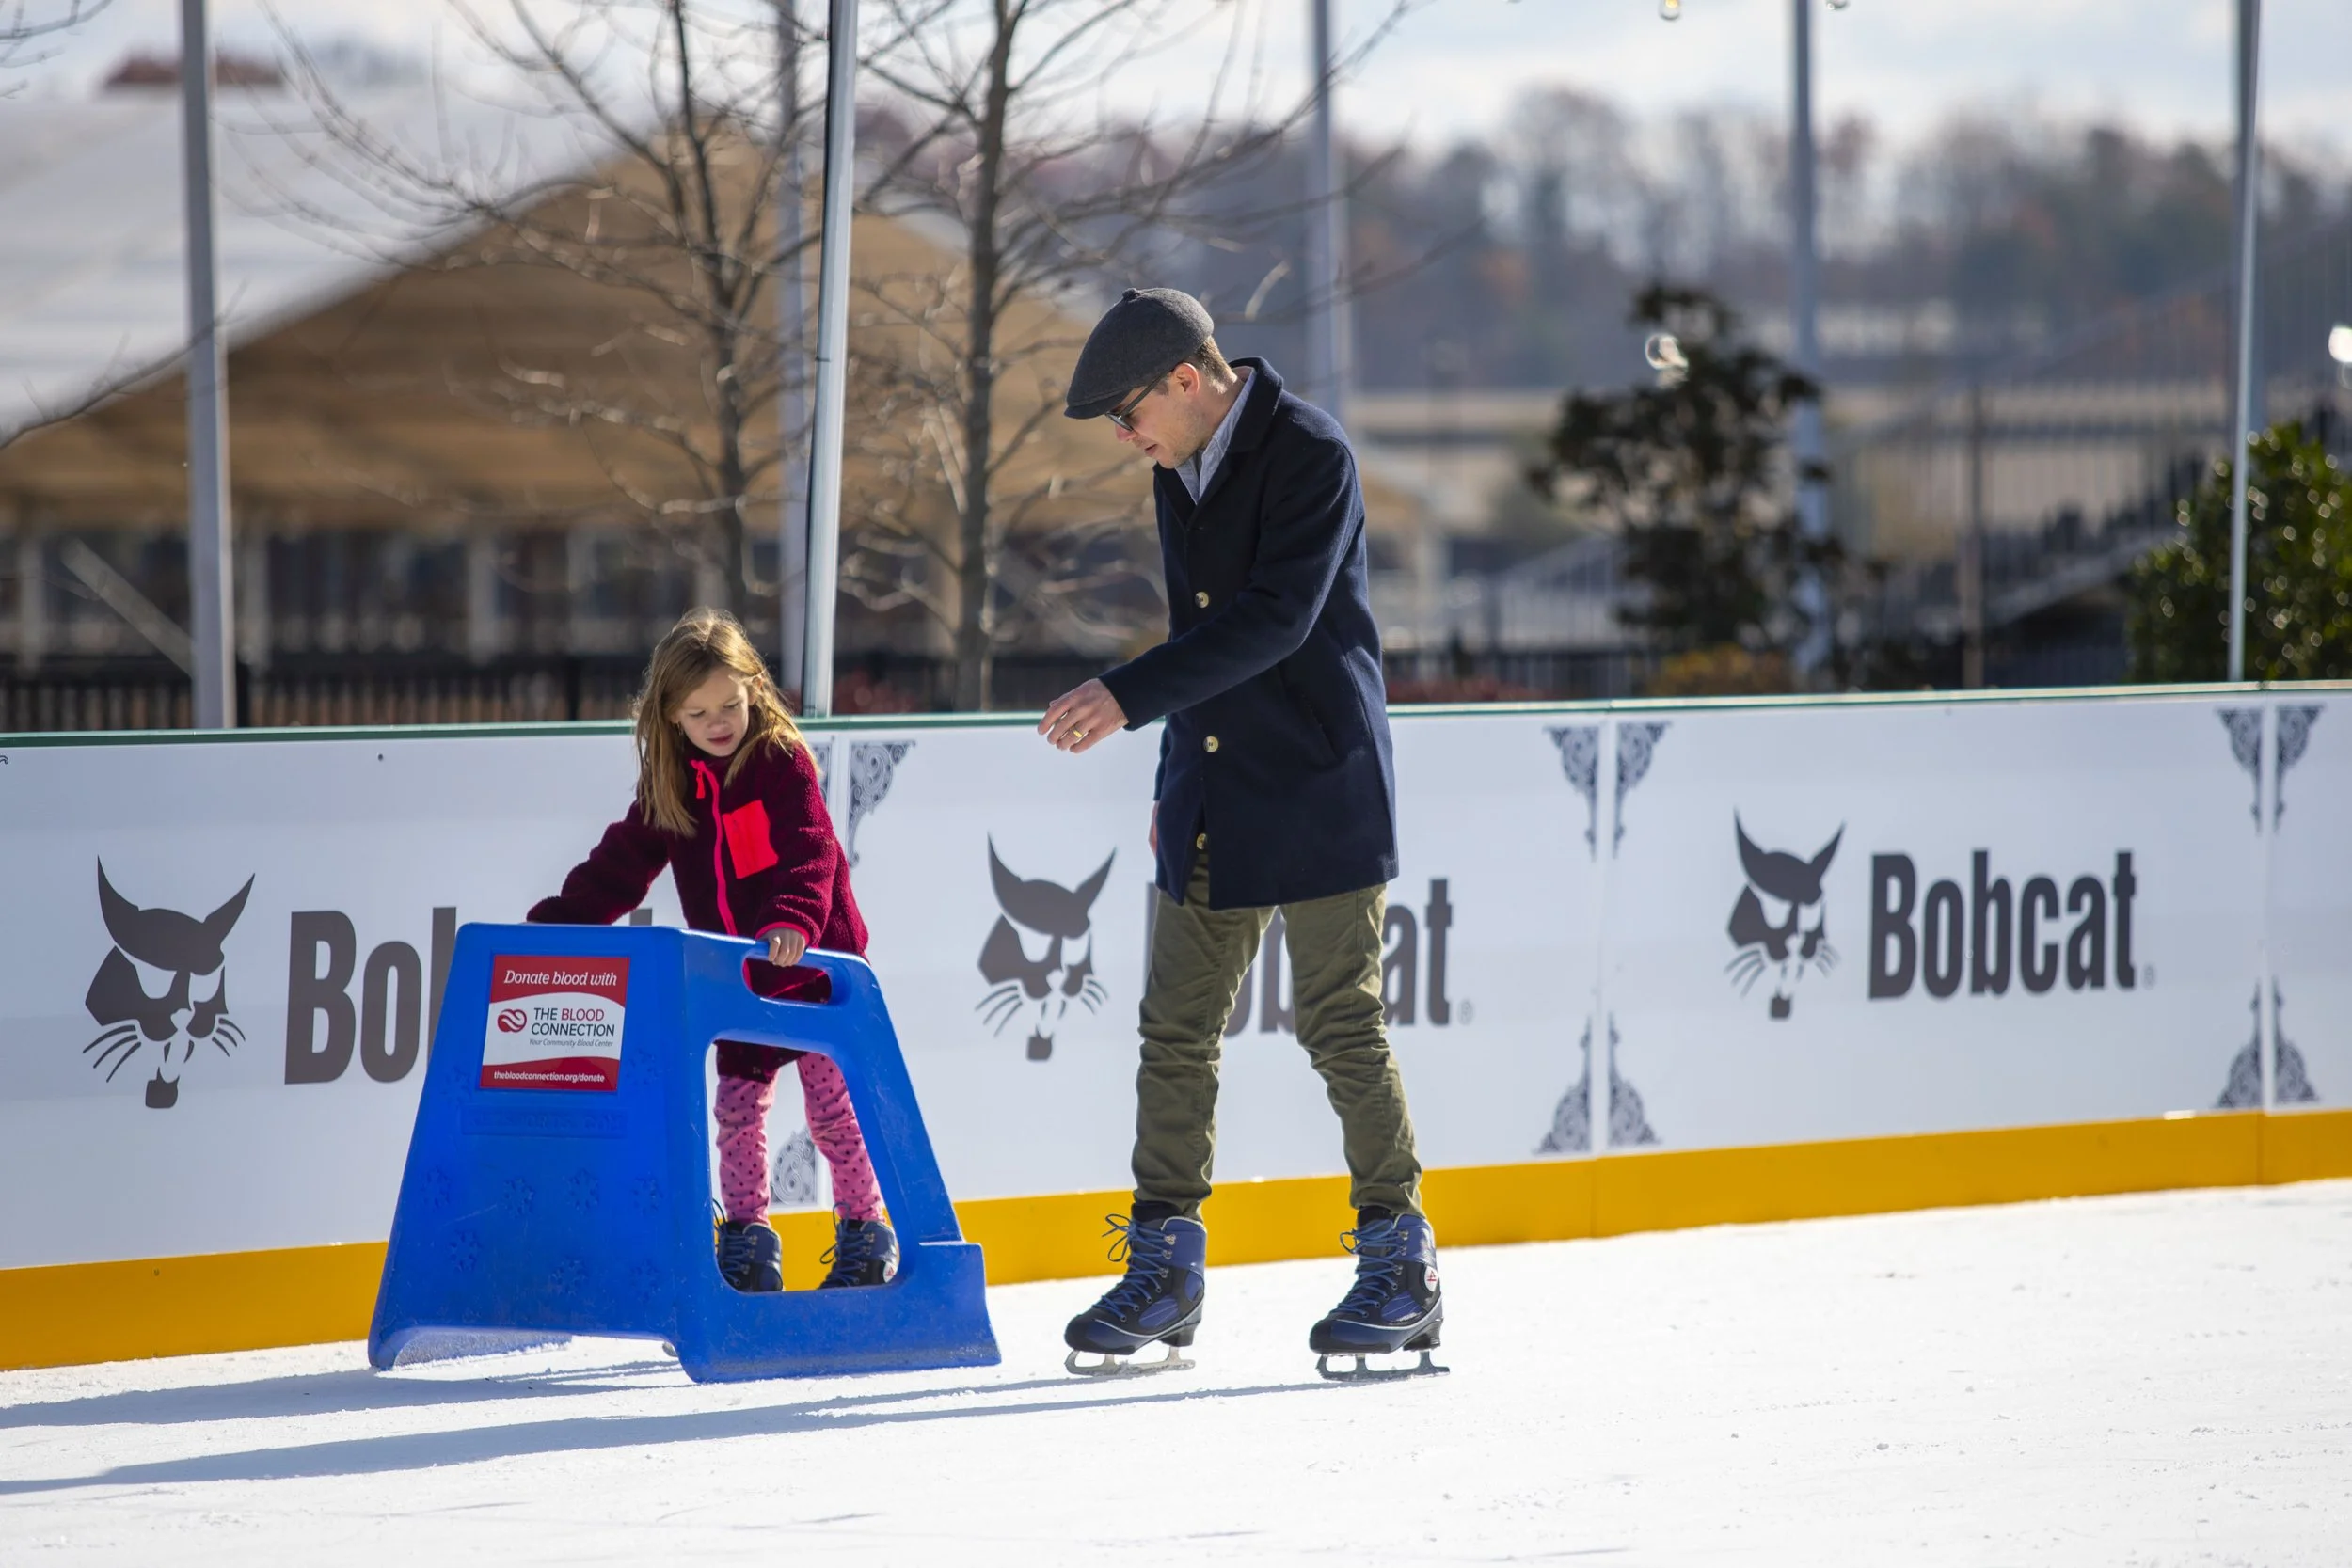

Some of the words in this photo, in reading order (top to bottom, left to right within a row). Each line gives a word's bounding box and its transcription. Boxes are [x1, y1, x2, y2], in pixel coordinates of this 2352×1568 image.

[1867, 850, 2137, 1002] Bobcat
[504, 970, 549, 985] Donate
[552, 971, 588, 986] blood
[590, 973, 617, 987] with
[533, 1007, 558, 1021] THE
[561, 1008, 604, 1022] BLOOD
[532, 1022, 615, 1037] CONNECTION
[543, 1038, 576, 1049] Community
[577, 1039, 594, 1048] Blood
[494, 1070, 605, 1084] thebloodconnection.org/donate
